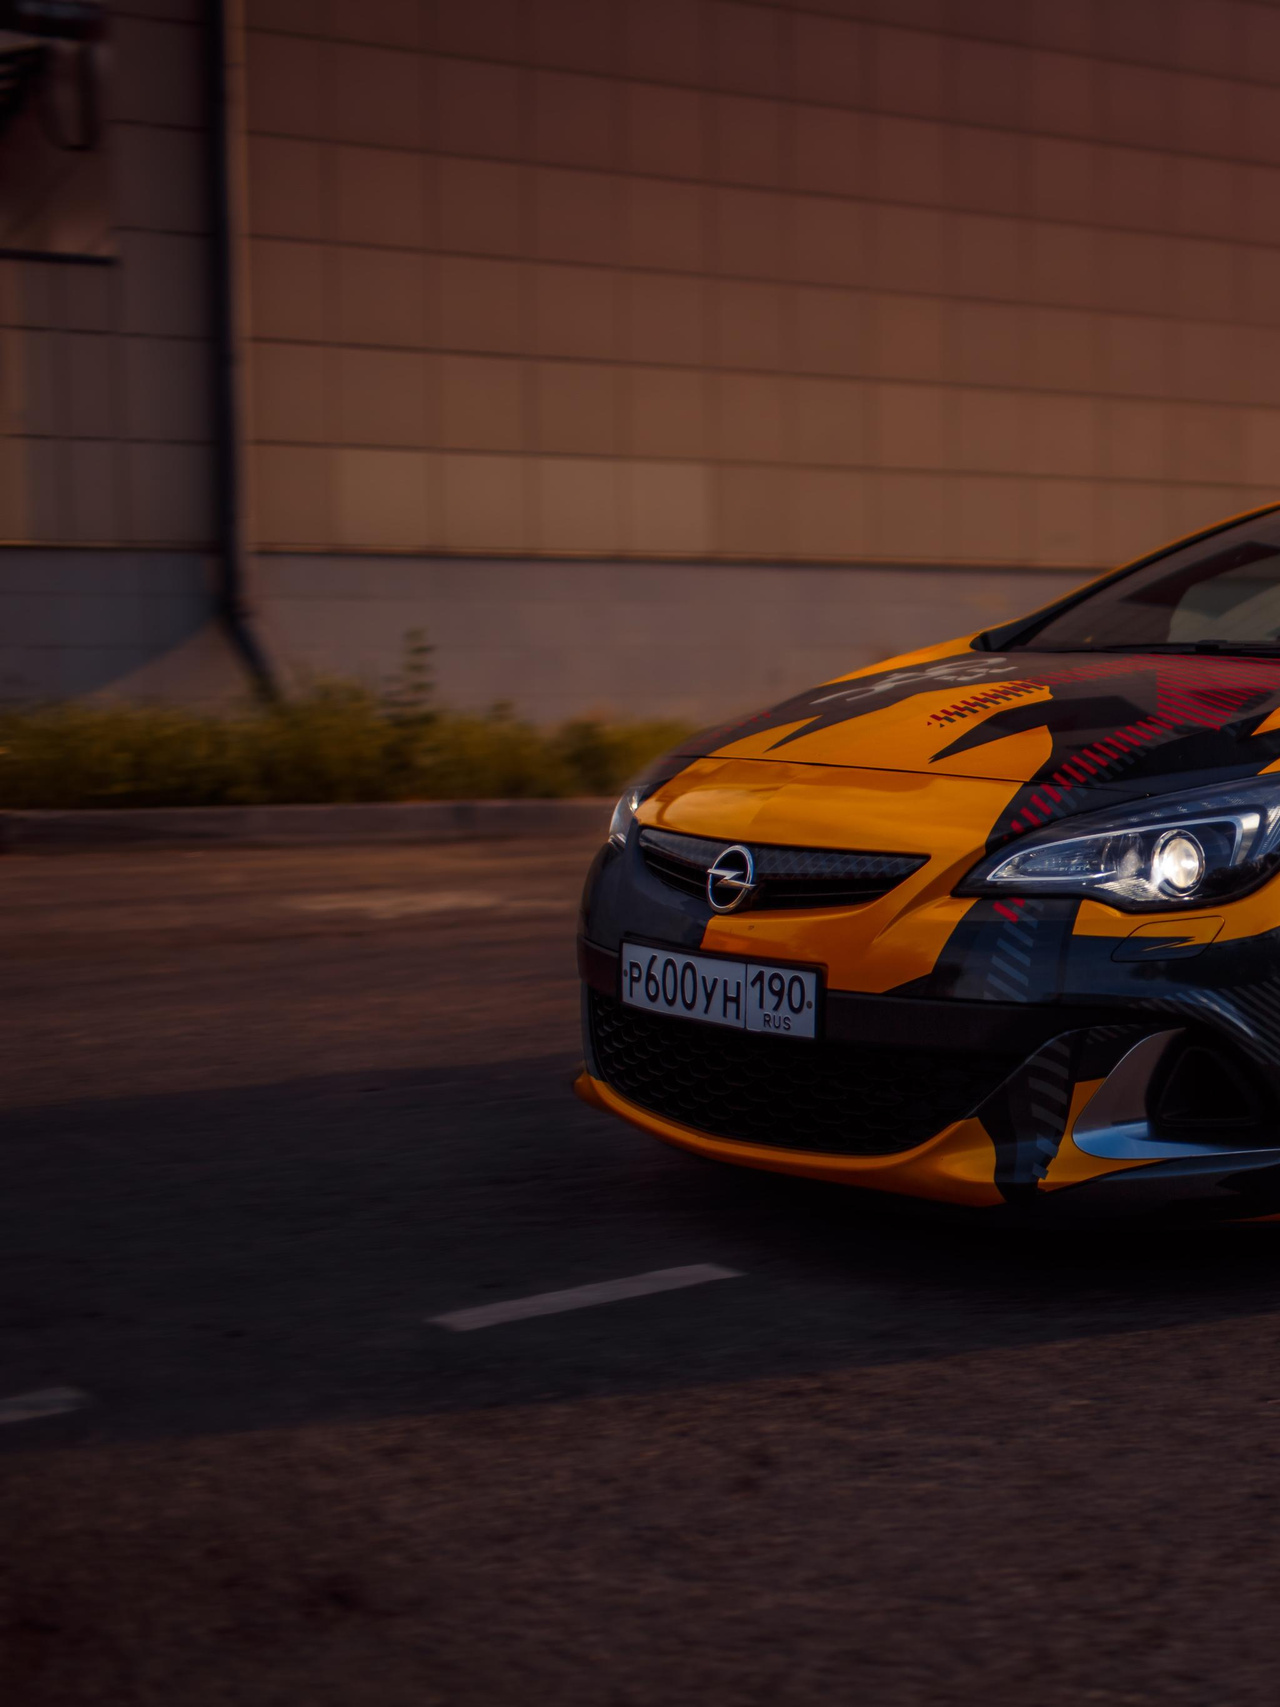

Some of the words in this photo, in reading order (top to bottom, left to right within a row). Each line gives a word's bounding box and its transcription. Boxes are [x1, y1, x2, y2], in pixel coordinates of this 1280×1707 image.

[629, 954, 742, 1020] Р600УН
[750, 970, 806, 1014] 190
[763, 1013, 792, 1030] RUS
